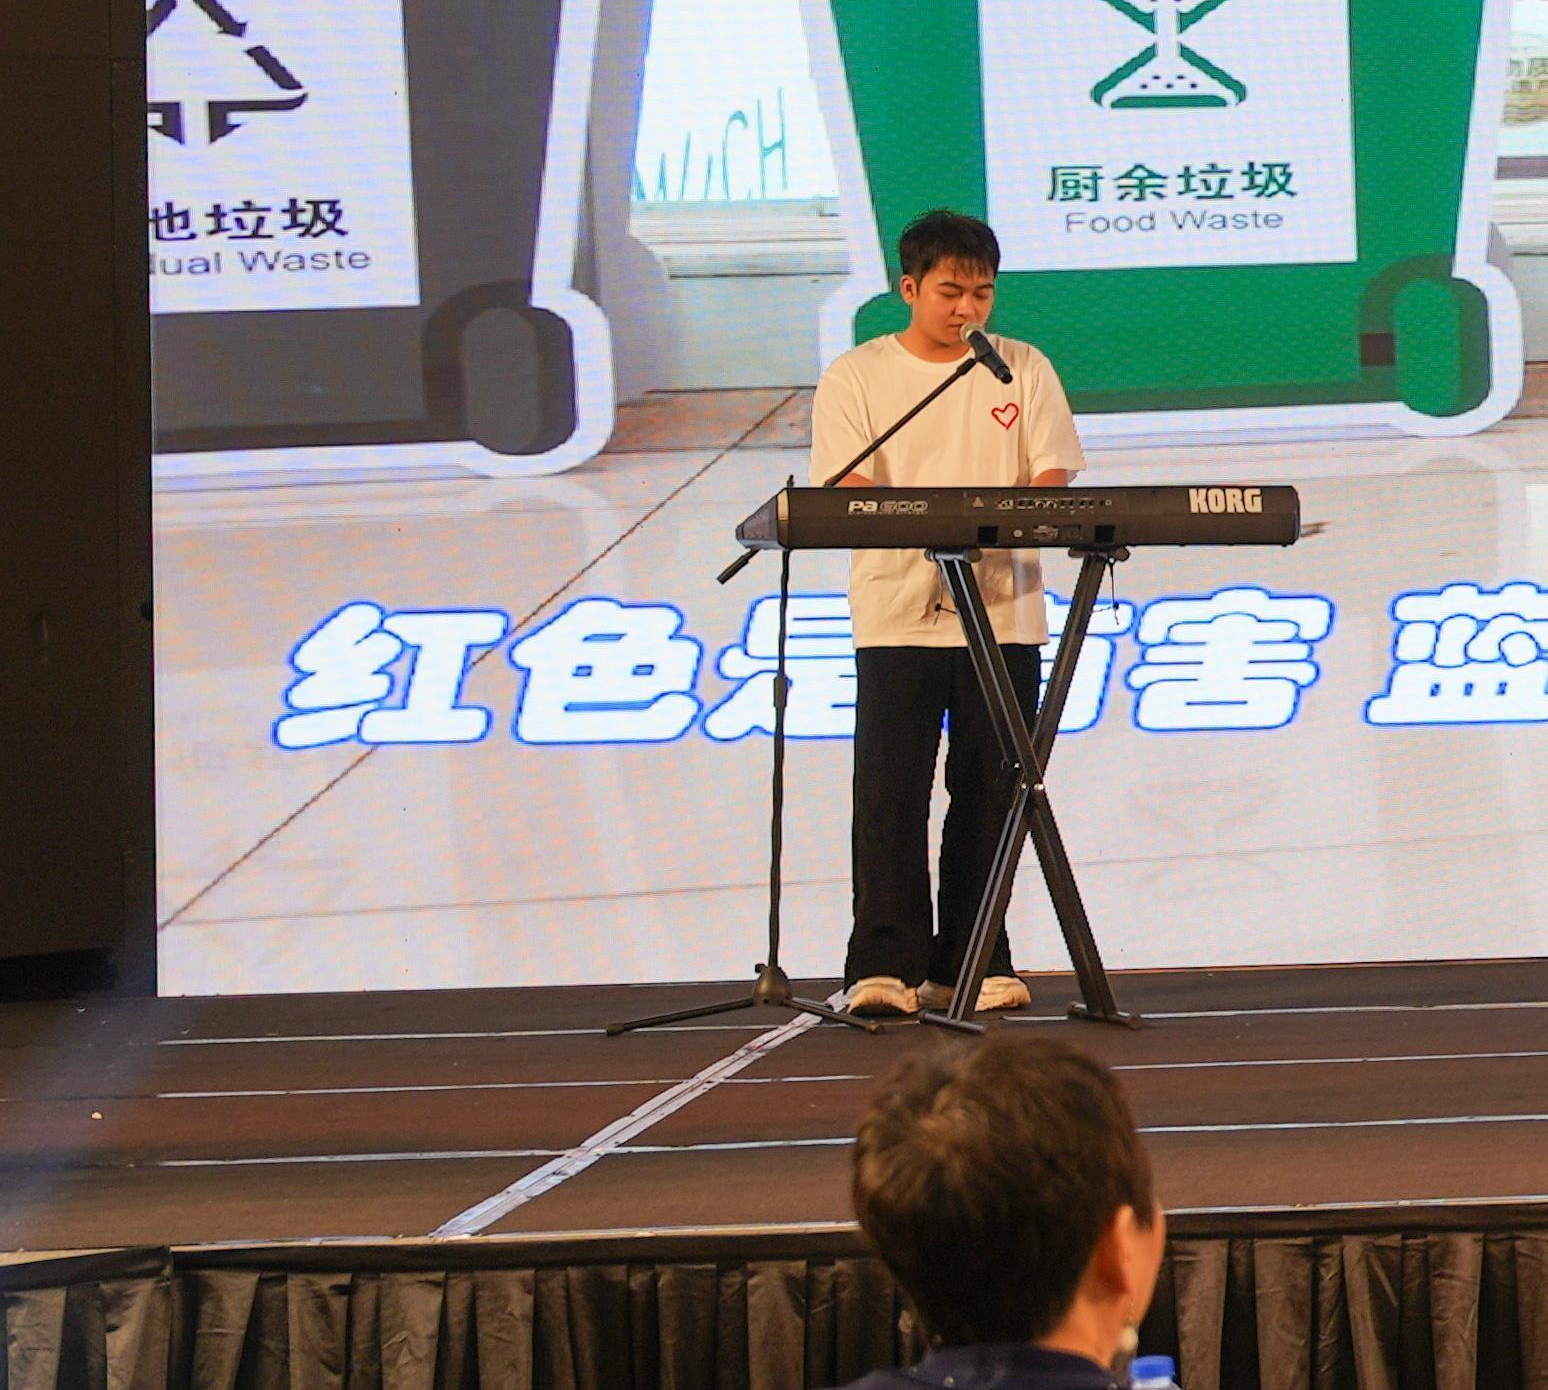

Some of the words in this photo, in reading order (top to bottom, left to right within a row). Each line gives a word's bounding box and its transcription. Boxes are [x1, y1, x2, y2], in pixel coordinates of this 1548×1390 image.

[1047, 161, 1299, 203] 厨余垃圾
[1064, 210, 1157, 234] Food
[1170, 208, 1284, 231] Waste
[236, 249, 372, 272] Waste
[1188, 488, 1263, 514] KORG
